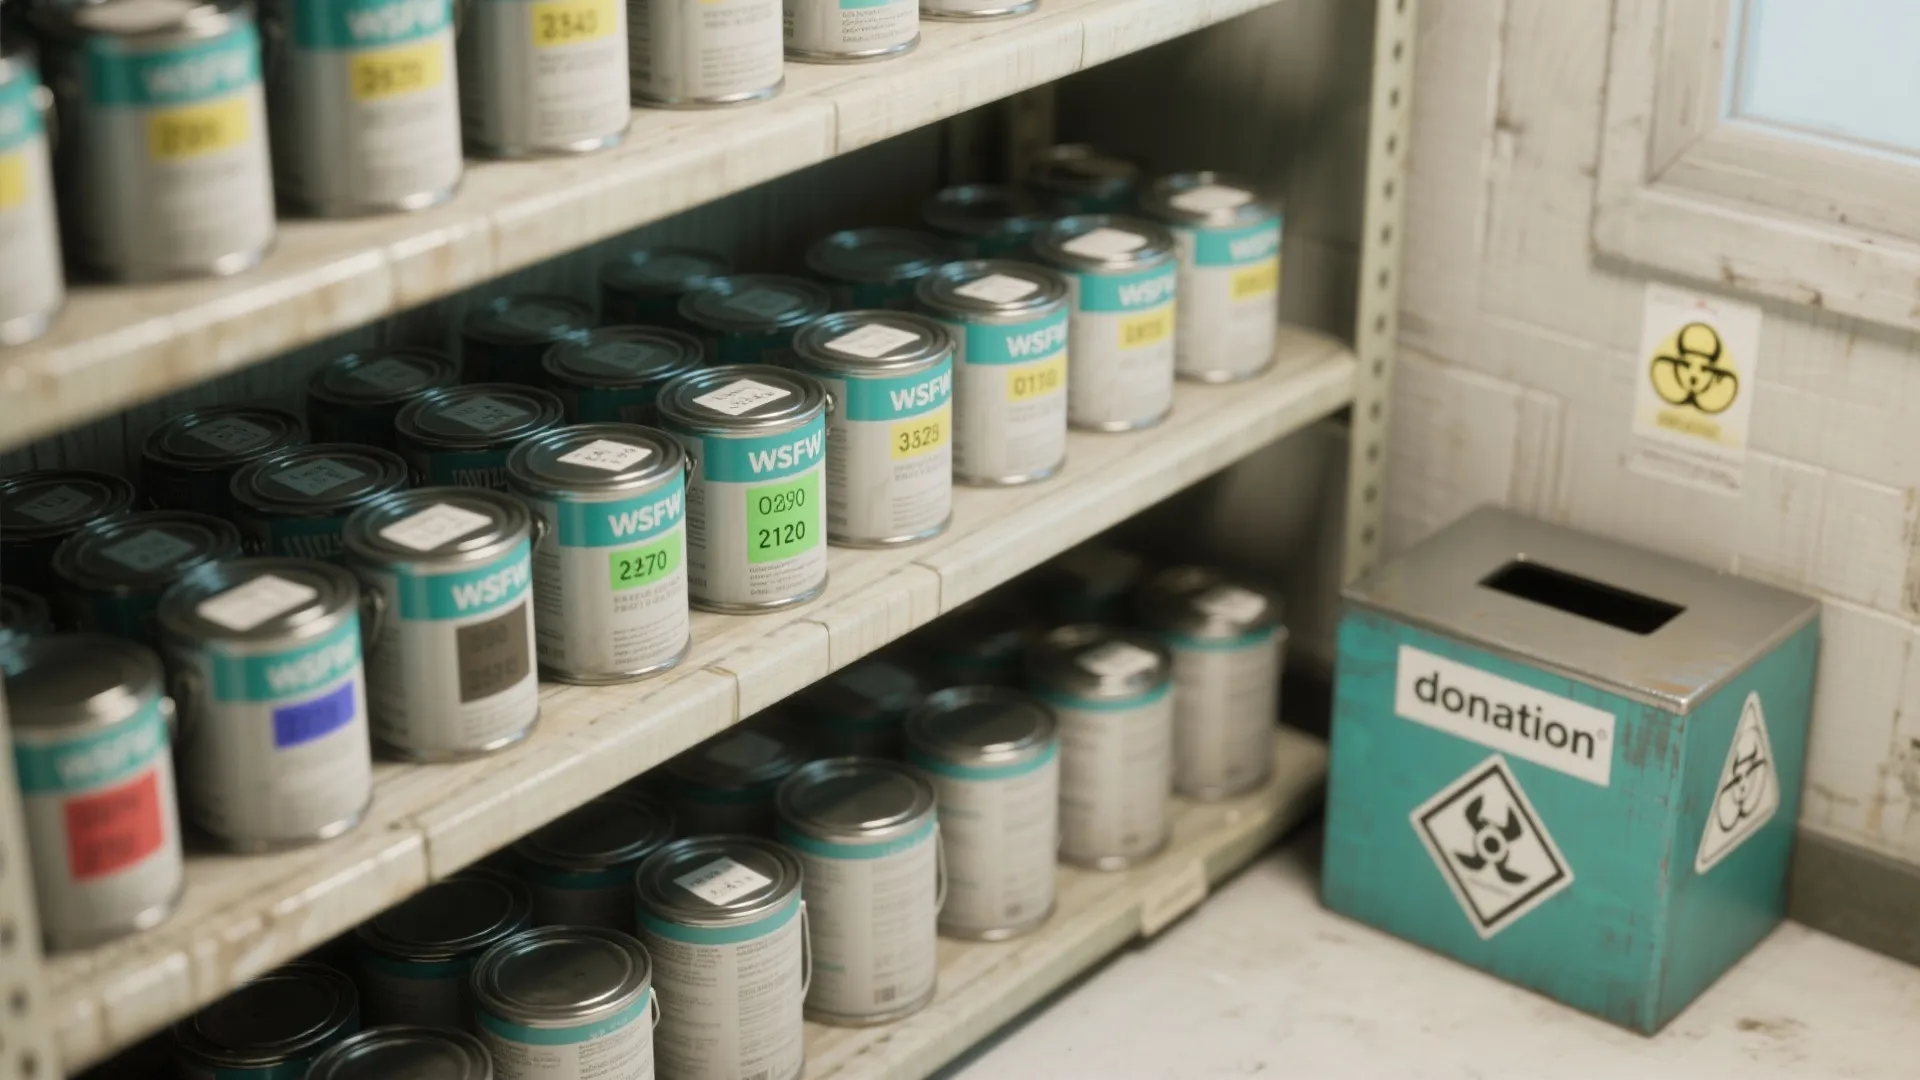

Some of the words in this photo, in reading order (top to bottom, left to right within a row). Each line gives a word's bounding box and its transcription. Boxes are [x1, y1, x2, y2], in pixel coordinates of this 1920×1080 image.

[748, 430, 822, 473] WSFW
[608, 487, 681, 537] WSFW
[759, 521, 805, 549] 2120
[1414, 670, 1595, 759] donation
